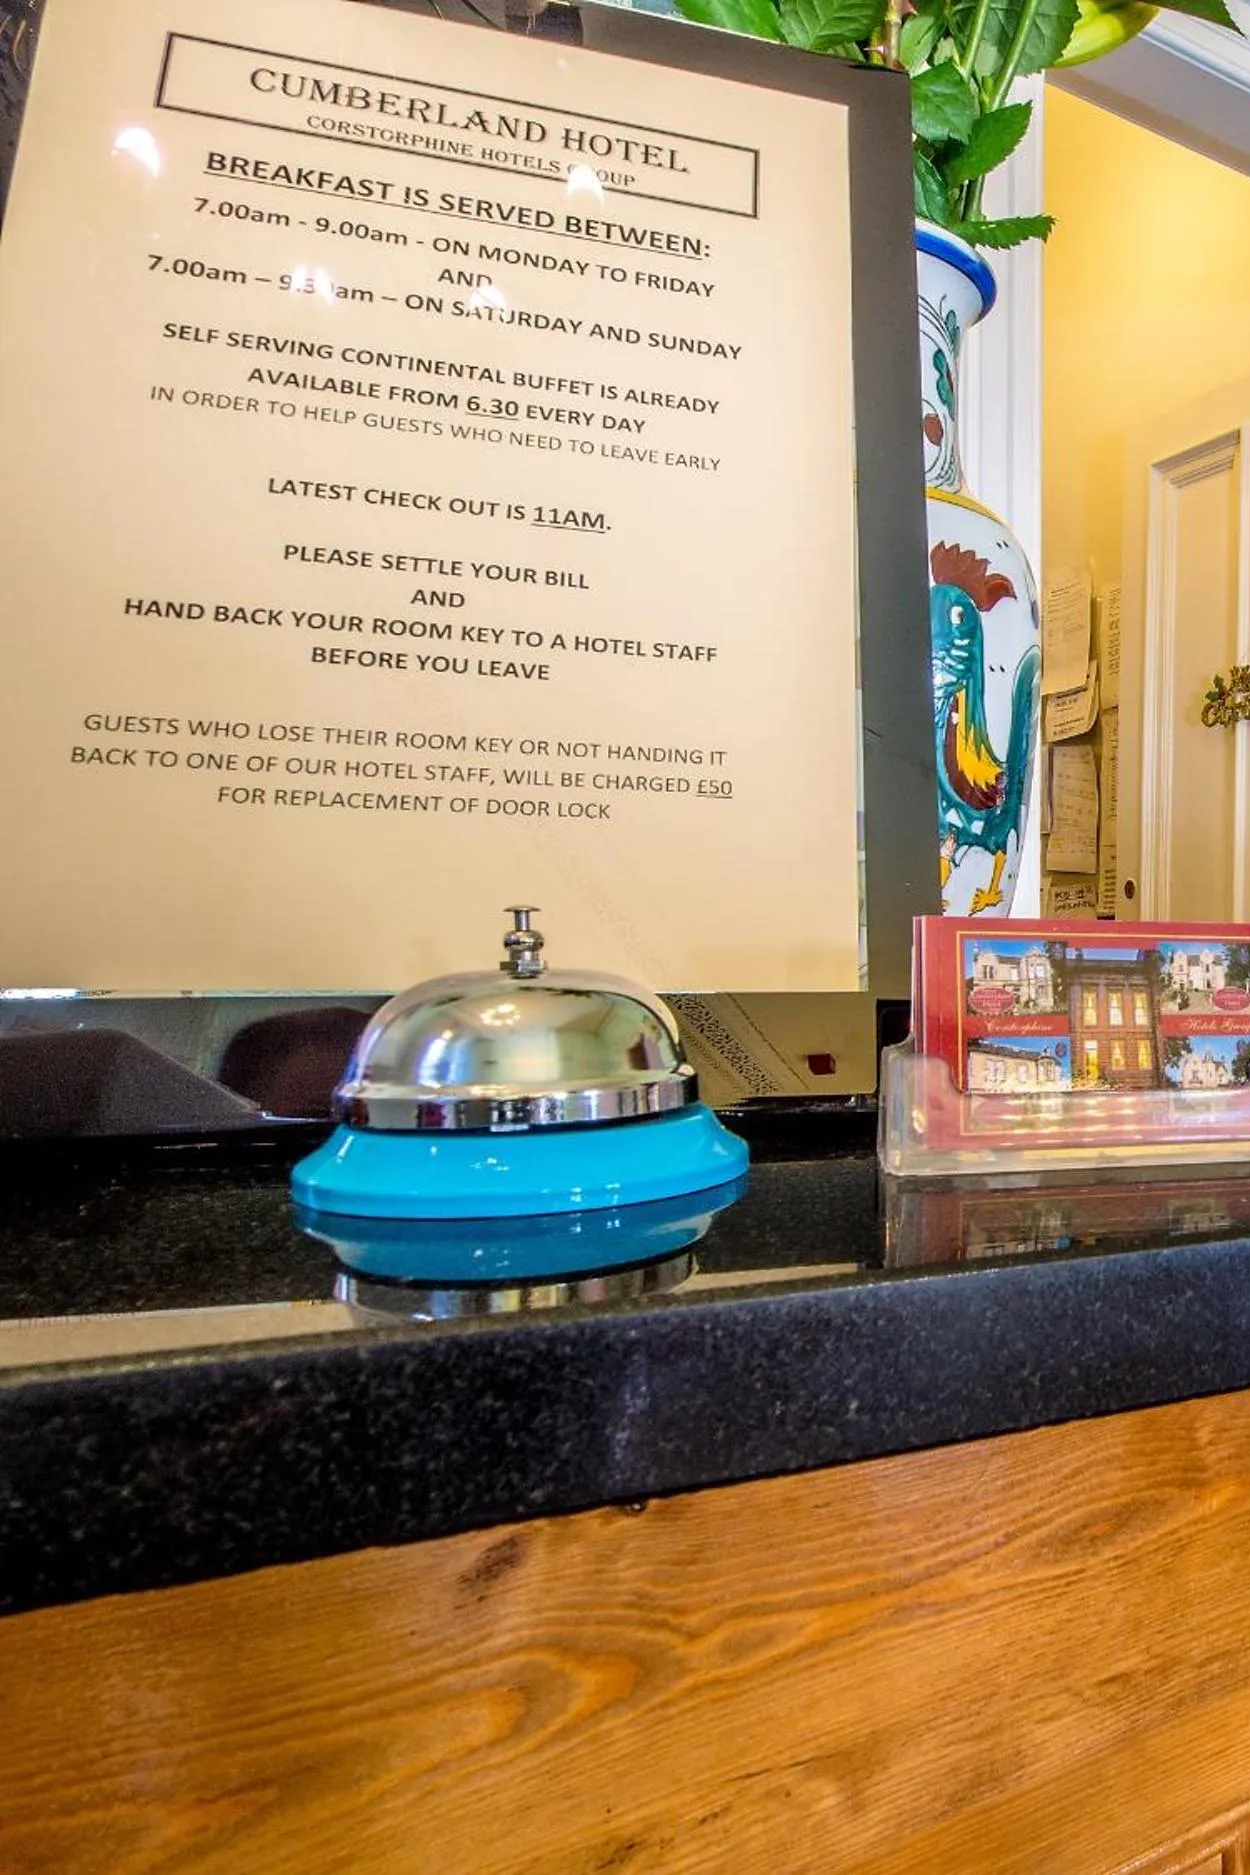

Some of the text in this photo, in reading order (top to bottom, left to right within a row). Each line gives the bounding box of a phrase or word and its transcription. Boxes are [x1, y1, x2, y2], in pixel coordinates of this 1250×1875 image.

[249, 67, 690, 174] CUMBERLAND HOTEL
[306, 114, 637, 188] CORSTORPHINE HOTELS OUP
[204, 151, 712, 258] BREAKFAST IS SERVED BETWEEN:
[194, 197, 291, 228] 7.00am
[314, 216, 408, 247] 9.00am
[431, 237, 470, 257] ON
[477, 243, 591, 277] MONDAY
[595, 264, 628, 283] TO
[634, 270, 715, 298] FRIDAY
[437, 268, 492, 288] AND
[147, 253, 248, 285] 7.00am
[278, 273, 375, 303] 9.3am
[404, 293, 444, 315] ON
[589, 323, 641, 345] AND
[647, 332, 743, 361] SUNDAY
[162, 322, 720, 415] SELF SERVING CONTINENTAL BUFFET IS ALREADY
[246, 367, 646, 435] AVAILABLE FROM 6.30 EVERY DAY
[150, 385, 721, 471] IN ORDER TO HELP GUESTS WHO NEED TO LEAVE EARLY
[268, 477, 612, 531] LATEST CHECK OUT IS 11AM.
[283, 544, 590, 590] PLEASE SETTLE YOUR BILL
[409, 588, 466, 609] AND
[123, 597, 718, 663] HAND BACK YOUR ROOM KEY TO A HOTEL STAFF
[310, 646, 550, 681] BEFORE YOU LEAVE
[70, 746, 733, 797] BACK TO ONE OF OUR HOTEL STAFF, WILL BE CHARGED £50
[83, 713, 727, 767] GUESTS WHO LOSE THEIR ROOM KEY OR NOT HANDING IT
[217, 785, 611, 820] FOR REPLACEMENT OF DOOR LOCK
